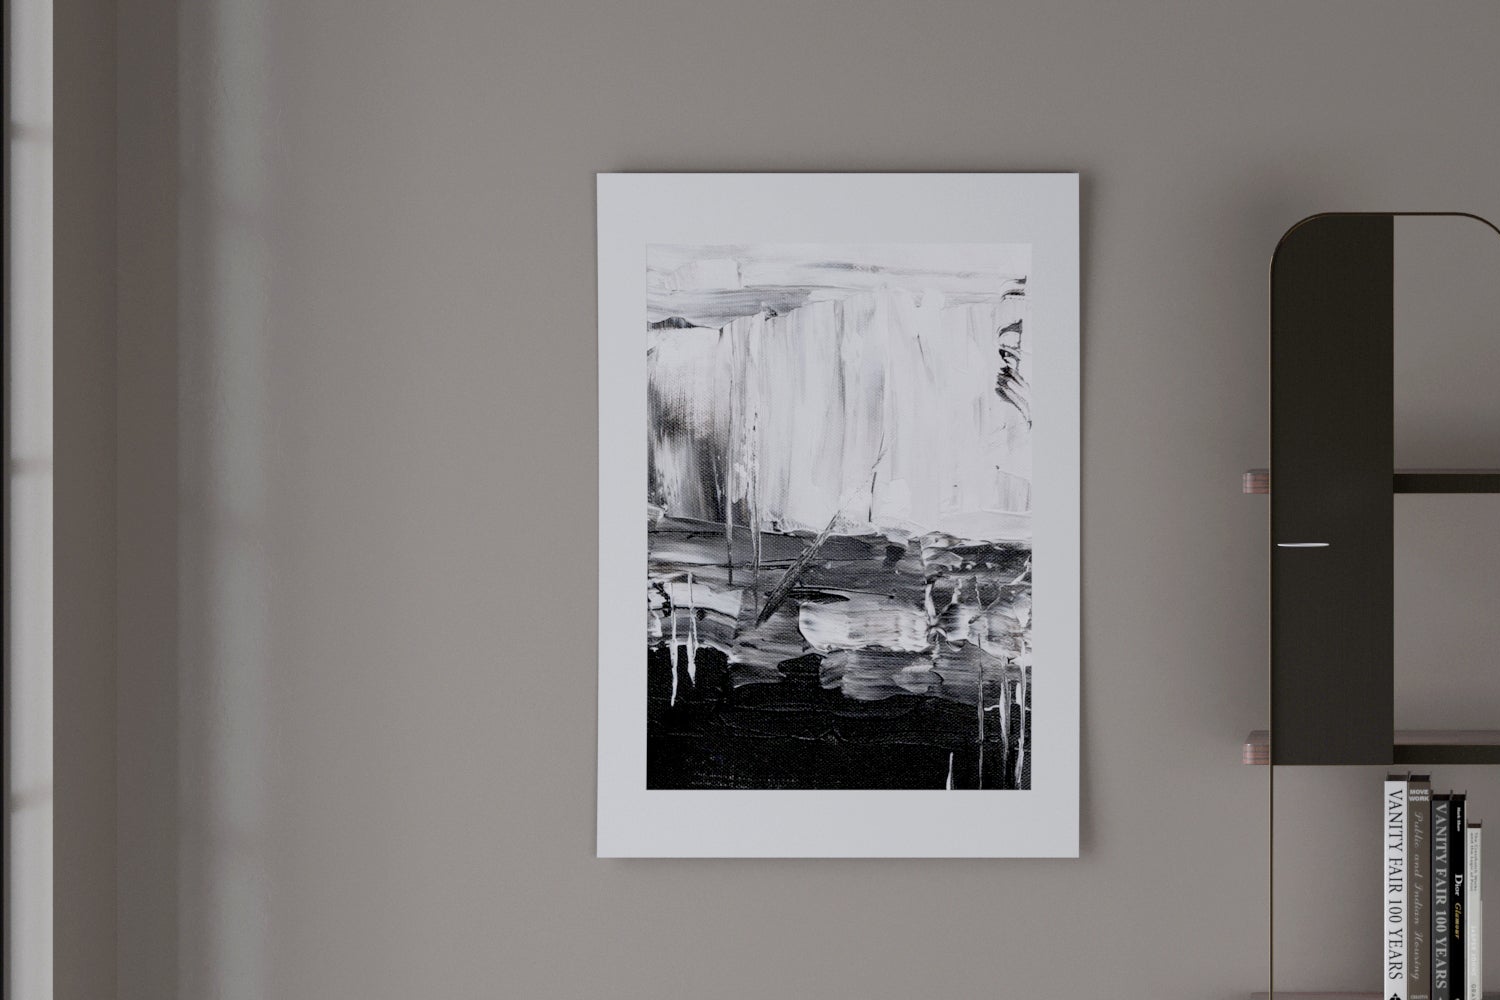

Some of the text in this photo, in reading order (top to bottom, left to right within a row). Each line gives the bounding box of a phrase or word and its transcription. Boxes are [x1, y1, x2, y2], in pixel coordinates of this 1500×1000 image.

[1389, 789, 1403, 980] VANITY FAIR 100 YEARS
[1414, 881, 1424, 925] Indian
[1435, 803, 1447, 989] VANITY FAIR 100 YEARS
[1454, 873, 1464, 940] Dior Glamour
[1410, 929, 1424, 980] Housing
